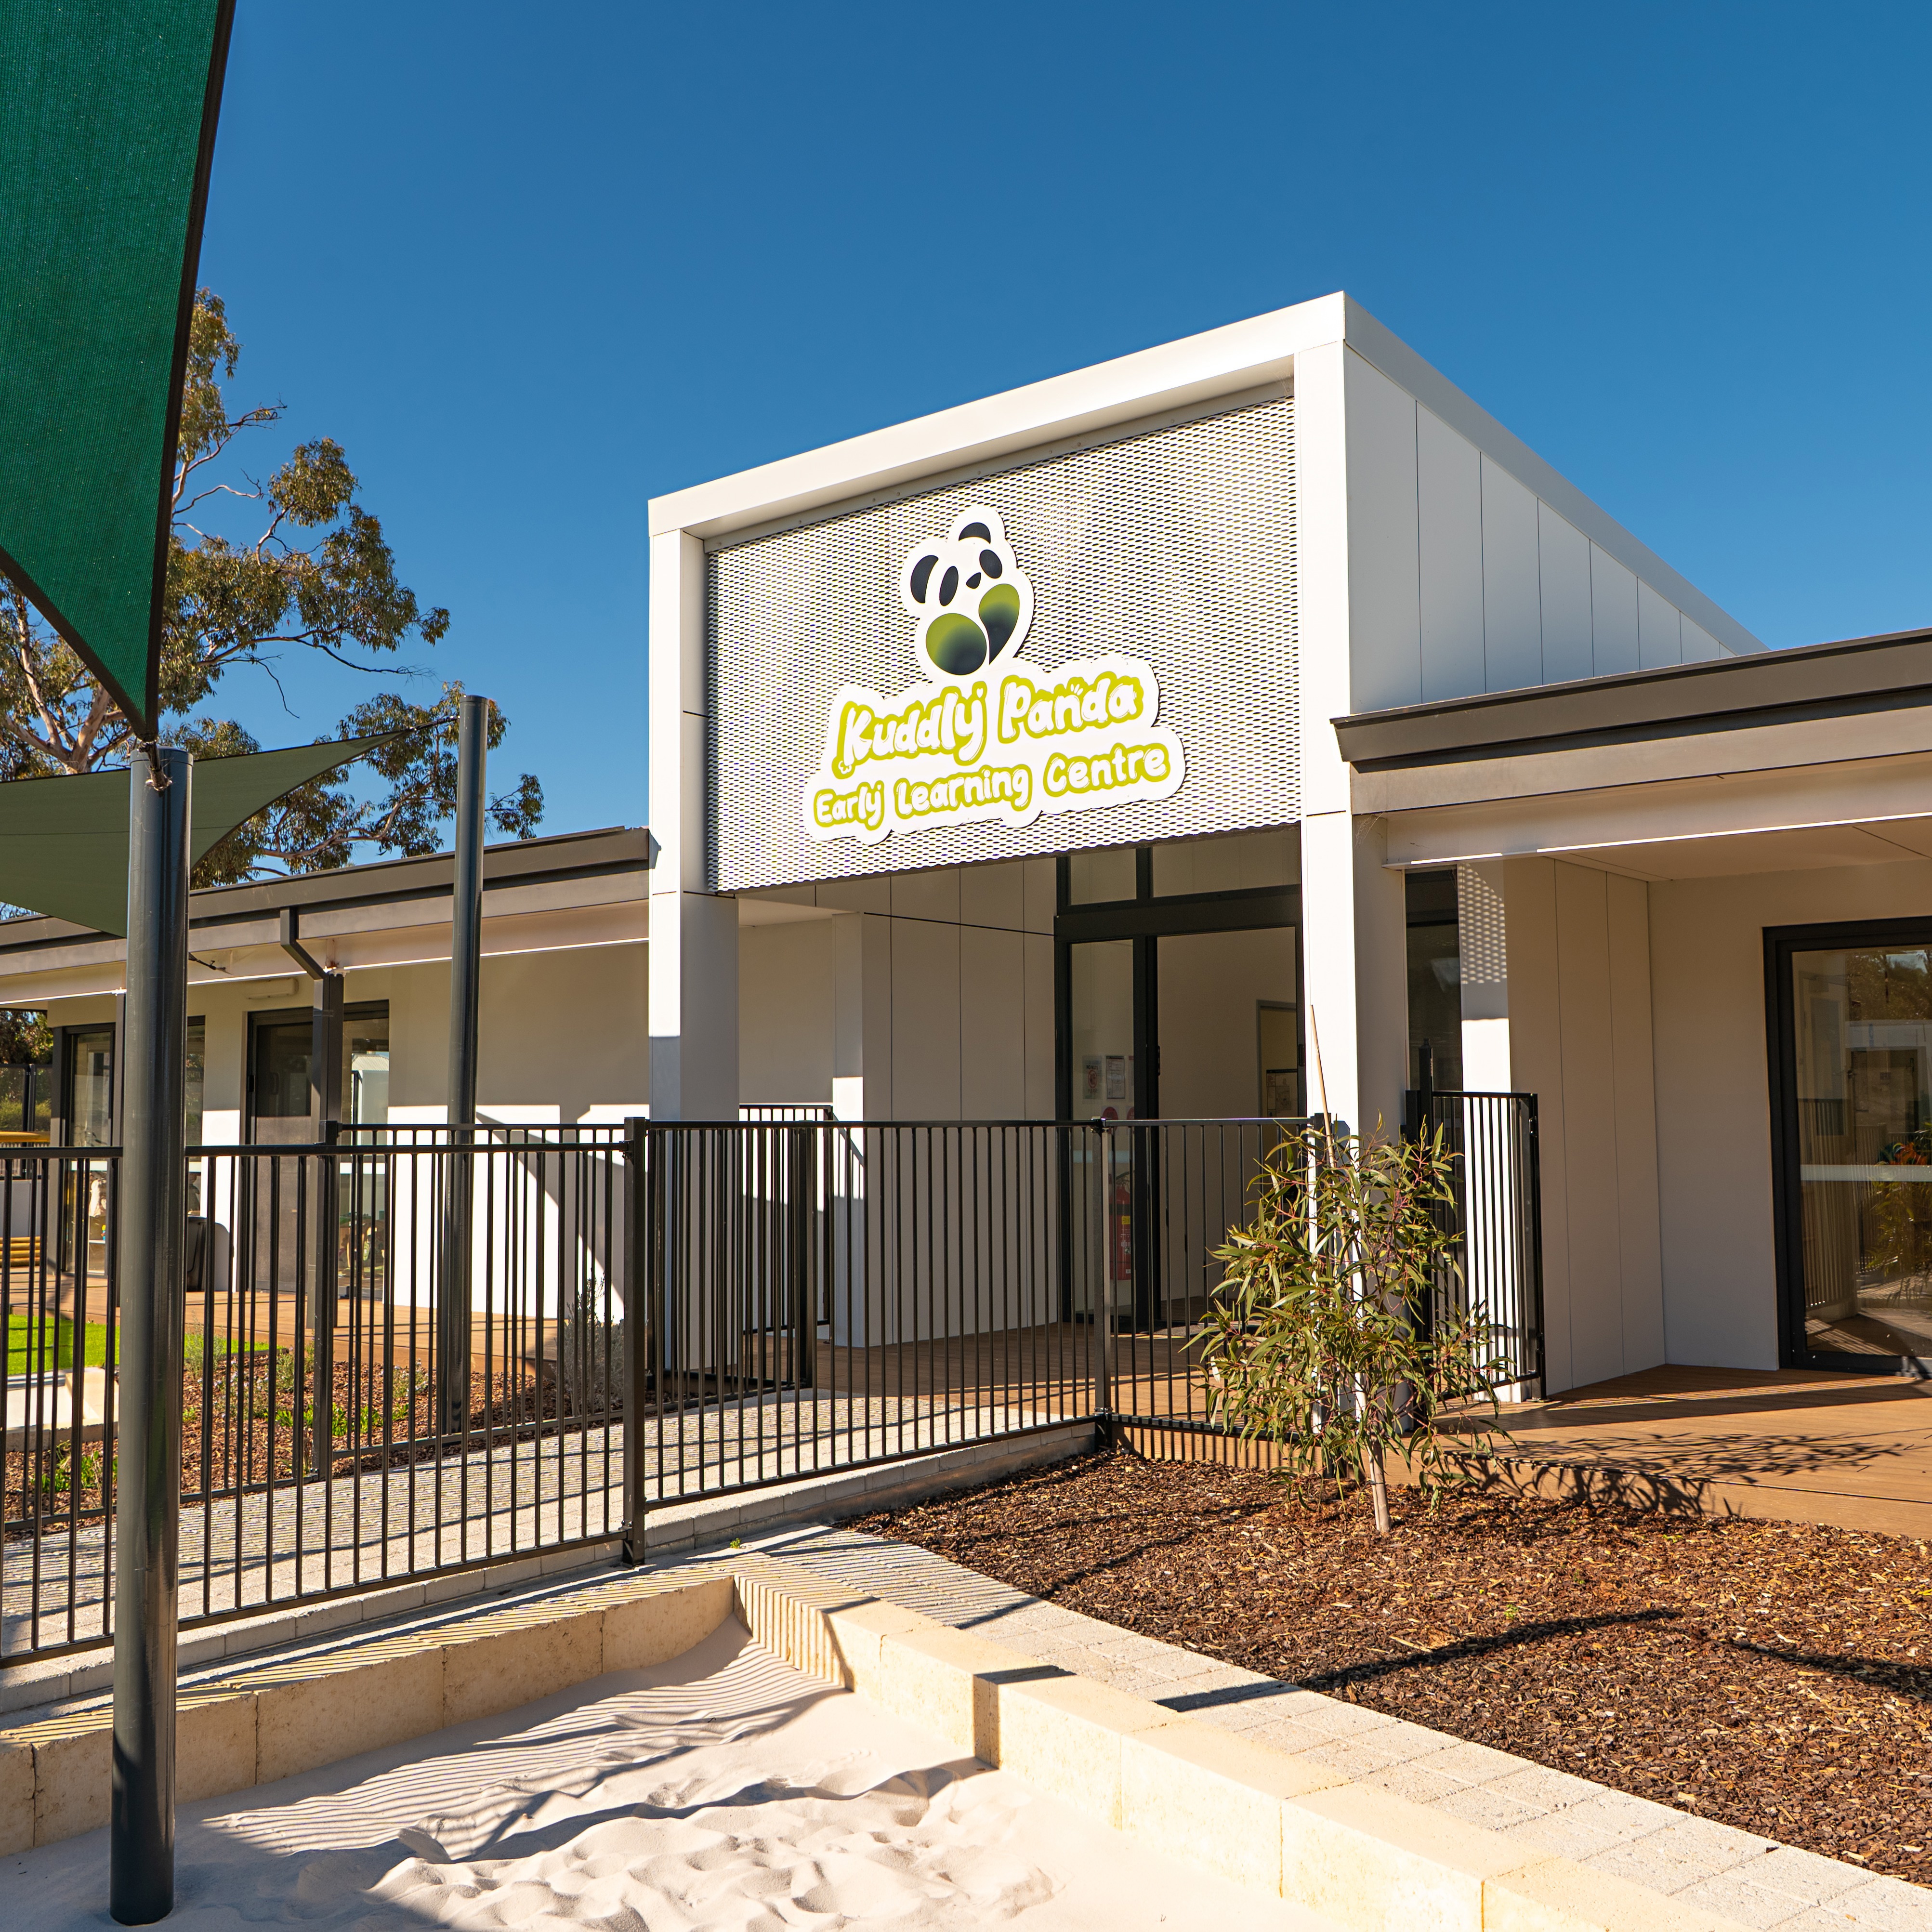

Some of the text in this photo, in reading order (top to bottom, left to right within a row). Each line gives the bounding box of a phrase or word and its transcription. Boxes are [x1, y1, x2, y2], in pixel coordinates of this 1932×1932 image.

[837, 676, 1139, 775] Kuddly Panda
[815, 746, 1168, 828] Early Learning Centre
